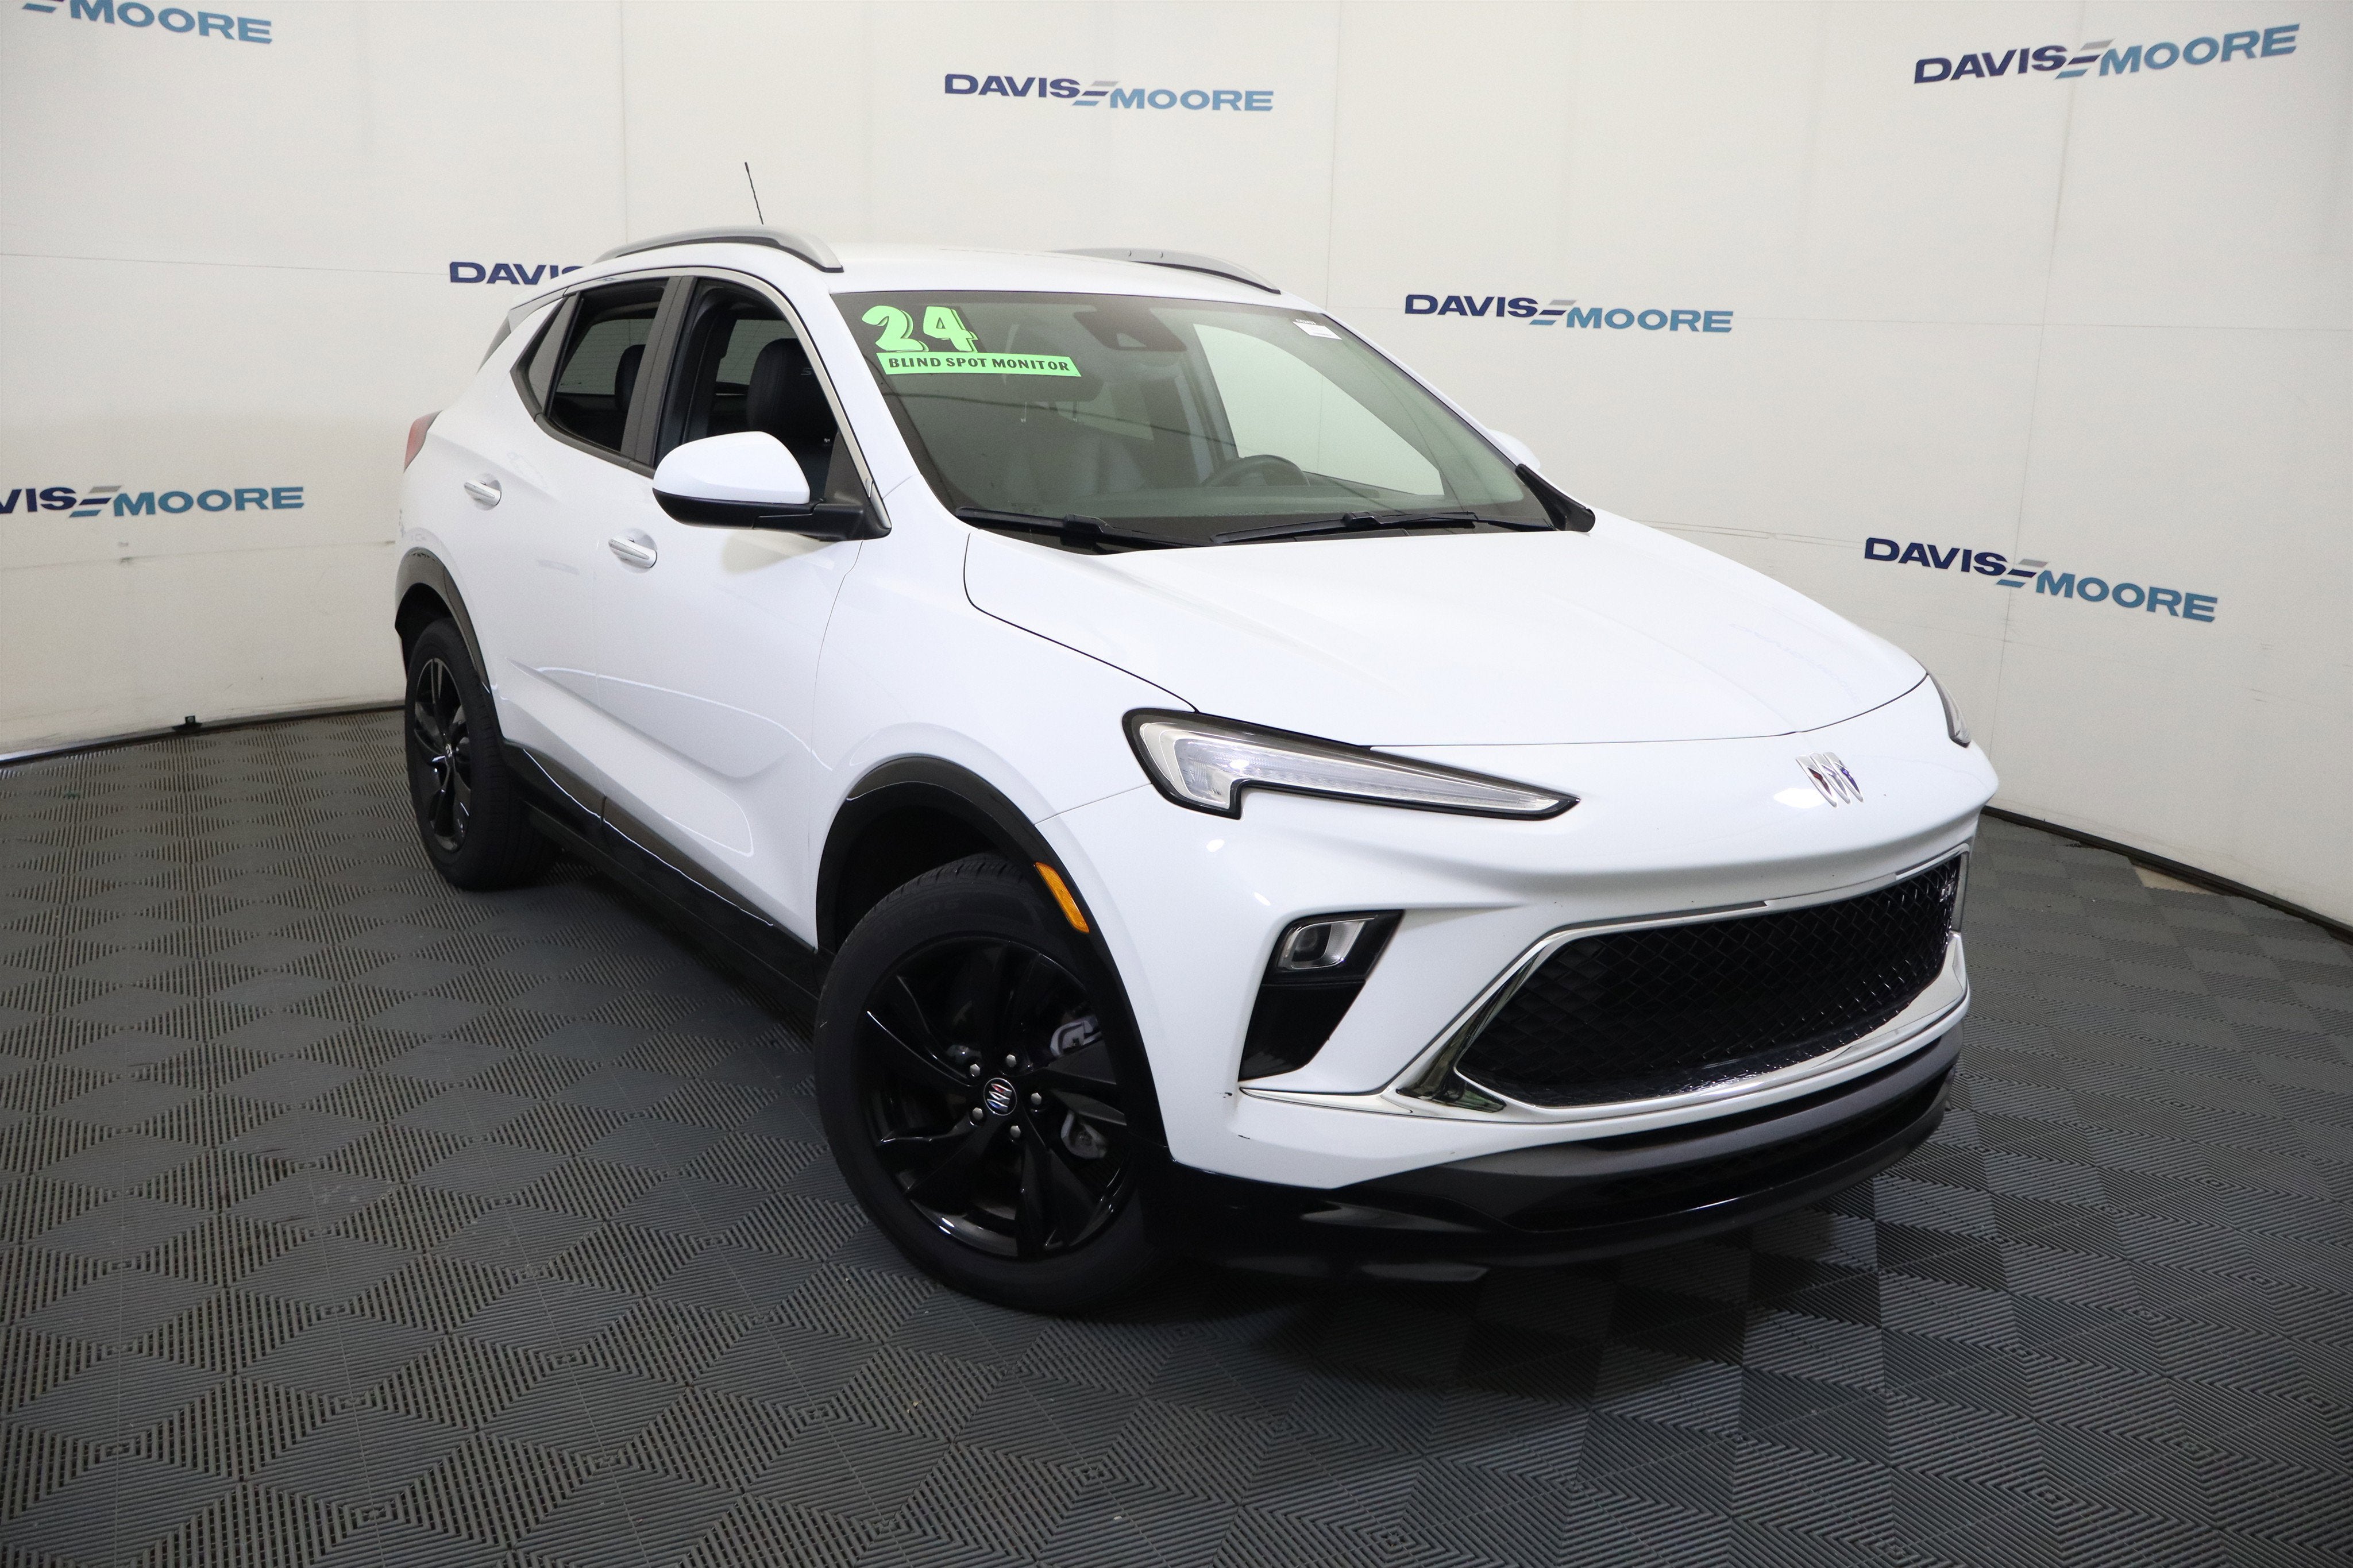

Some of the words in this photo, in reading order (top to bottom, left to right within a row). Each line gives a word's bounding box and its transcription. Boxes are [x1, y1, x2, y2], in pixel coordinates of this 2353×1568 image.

[70, 0, 272, 44] MOORE
[1914, 45, 2067, 84] DAVIS
[2099, 23, 2301, 76] MOORE
[944, 73, 1081, 99] DAVIS
[1110, 88, 1274, 111] MOORE
[862, 306, 979, 353] 24
[1405, 293, 1538, 318] DAVIS
[1566, 307, 1734, 333] MOORE
[889, 357, 942, 368] BLIND
[946, 357, 987, 368] SPOT
[992, 358, 1070, 371] MONITOR
[113, 486, 304, 517] MOORE
[1864, 536, 2008, 577] DAVIS
[2035, 570, 2218, 623] MOORE
